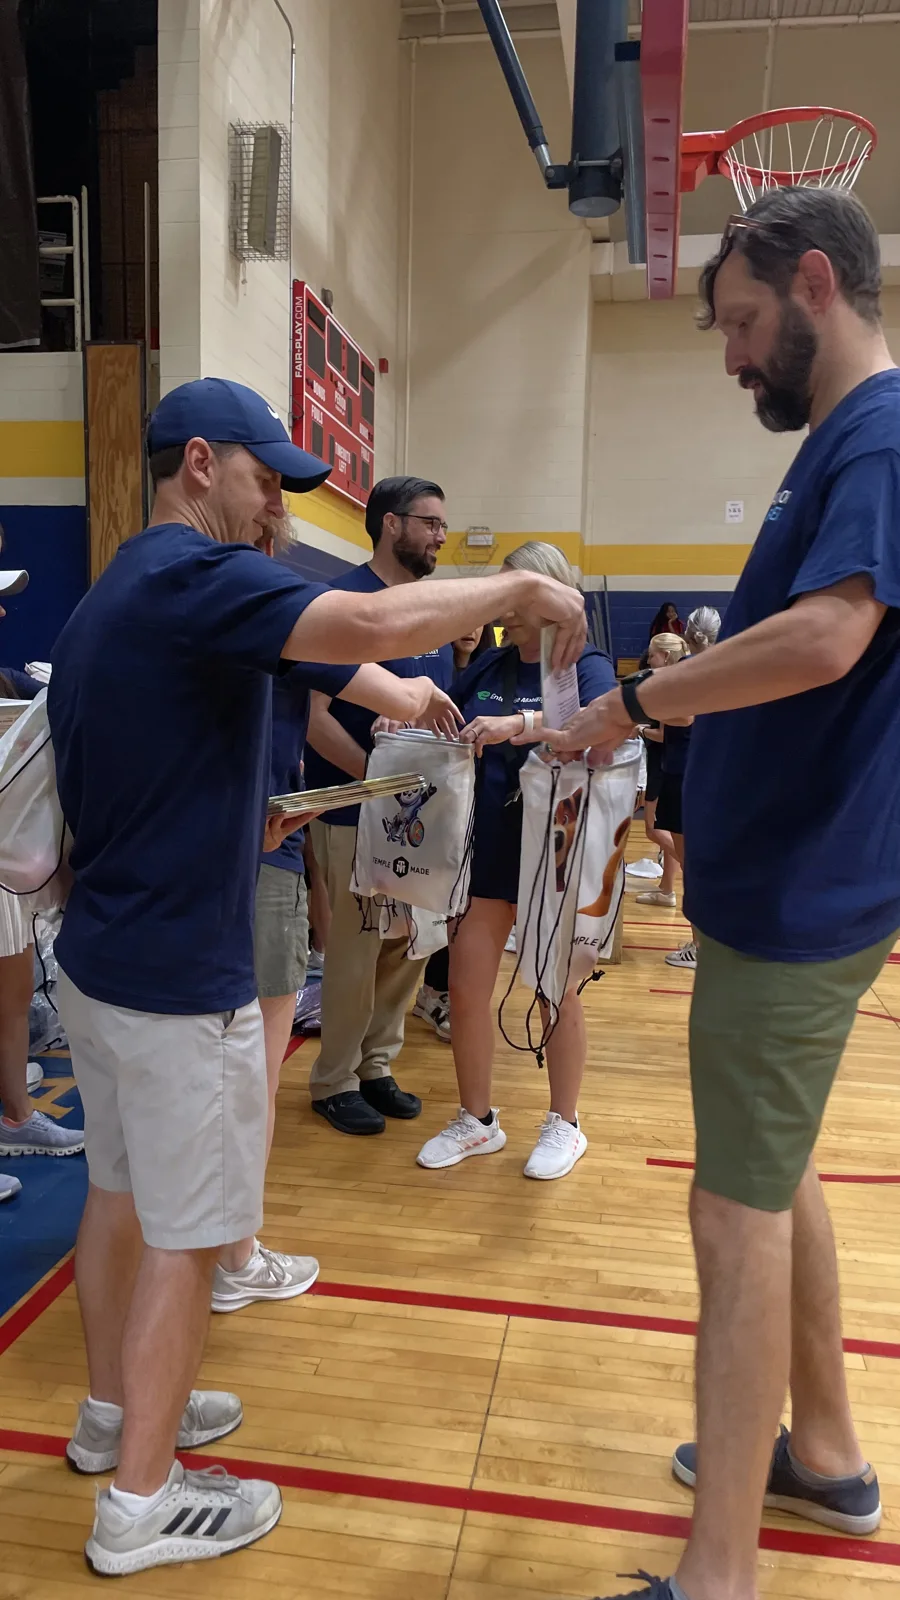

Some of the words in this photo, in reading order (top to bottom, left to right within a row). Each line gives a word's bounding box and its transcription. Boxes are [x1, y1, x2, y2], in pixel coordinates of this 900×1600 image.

[295, 296, 303, 378] FAIR-PLAY.COM
[311, 404, 323, 425] FOULS
[338, 459, 347, 475] LEFT
[372, 856, 391, 869] TEMPLE
[410, 866, 430, 876] MADE
